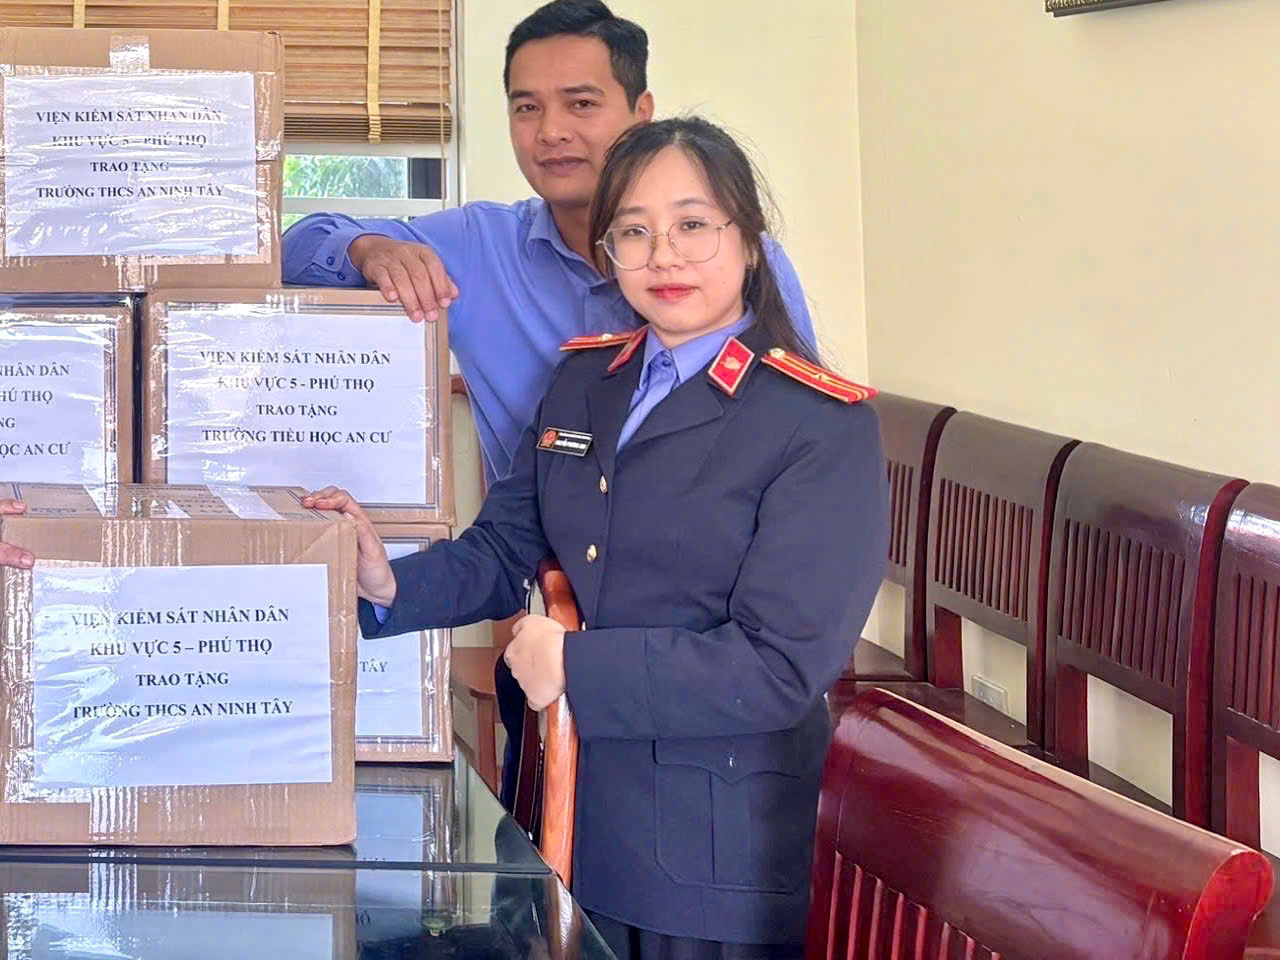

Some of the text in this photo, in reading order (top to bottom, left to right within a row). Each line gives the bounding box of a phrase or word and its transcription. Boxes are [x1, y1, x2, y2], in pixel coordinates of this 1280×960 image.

[36, 111, 71, 124] VIỆN
[74, 108, 114, 123] KIỂM
[116, 107, 143, 122] SÁT
[52, 135, 82, 147] KHU
[175, 134, 207, 149] THỌ
[90, 160, 169, 175] TRAO TẶNG
[36, 185, 95, 199] TRƯỜNG
[98, 186, 134, 198] THCS
[137, 186, 156, 198] AN
[199, 183, 224, 198] TÂY
[199, 349, 391, 366] VIỆN KIỂM SÁT NHÂN DÂN
[39, 361, 70, 377] DÂN
[253, 376, 286, 391] VỰC
[290, 378, 298, 389] 5
[310, 375, 340, 390] PHÚ
[343, 378, 375, 392] THỌ
[21, 390, 54, 405] THỌ
[256, 404, 338, 418] TRAO TẶNG
[201, 427, 392, 445] TRƯỜNG TIỂU HỌC AN CƯ
[24, 443, 45, 456] AN
[48, 441, 71, 456] CƯ
[117, 607, 162, 625] KIỂM
[166, 607, 199, 624] SÁT
[202, 606, 250, 623] NHÂN
[255, 604, 289, 622] DÂN
[90, 642, 126, 656] KHU
[132, 640, 169, 658] VỰC
[173, 641, 182, 654] 5
[198, 636, 232, 654] PHÚ
[235, 639, 273, 656] THỌ
[359, 658, 388, 673] TÂY
[136, 672, 229, 689] TRAO TẶNG
[72, 700, 294, 719] TRƯỜNG THCS AN NINH TÂY
